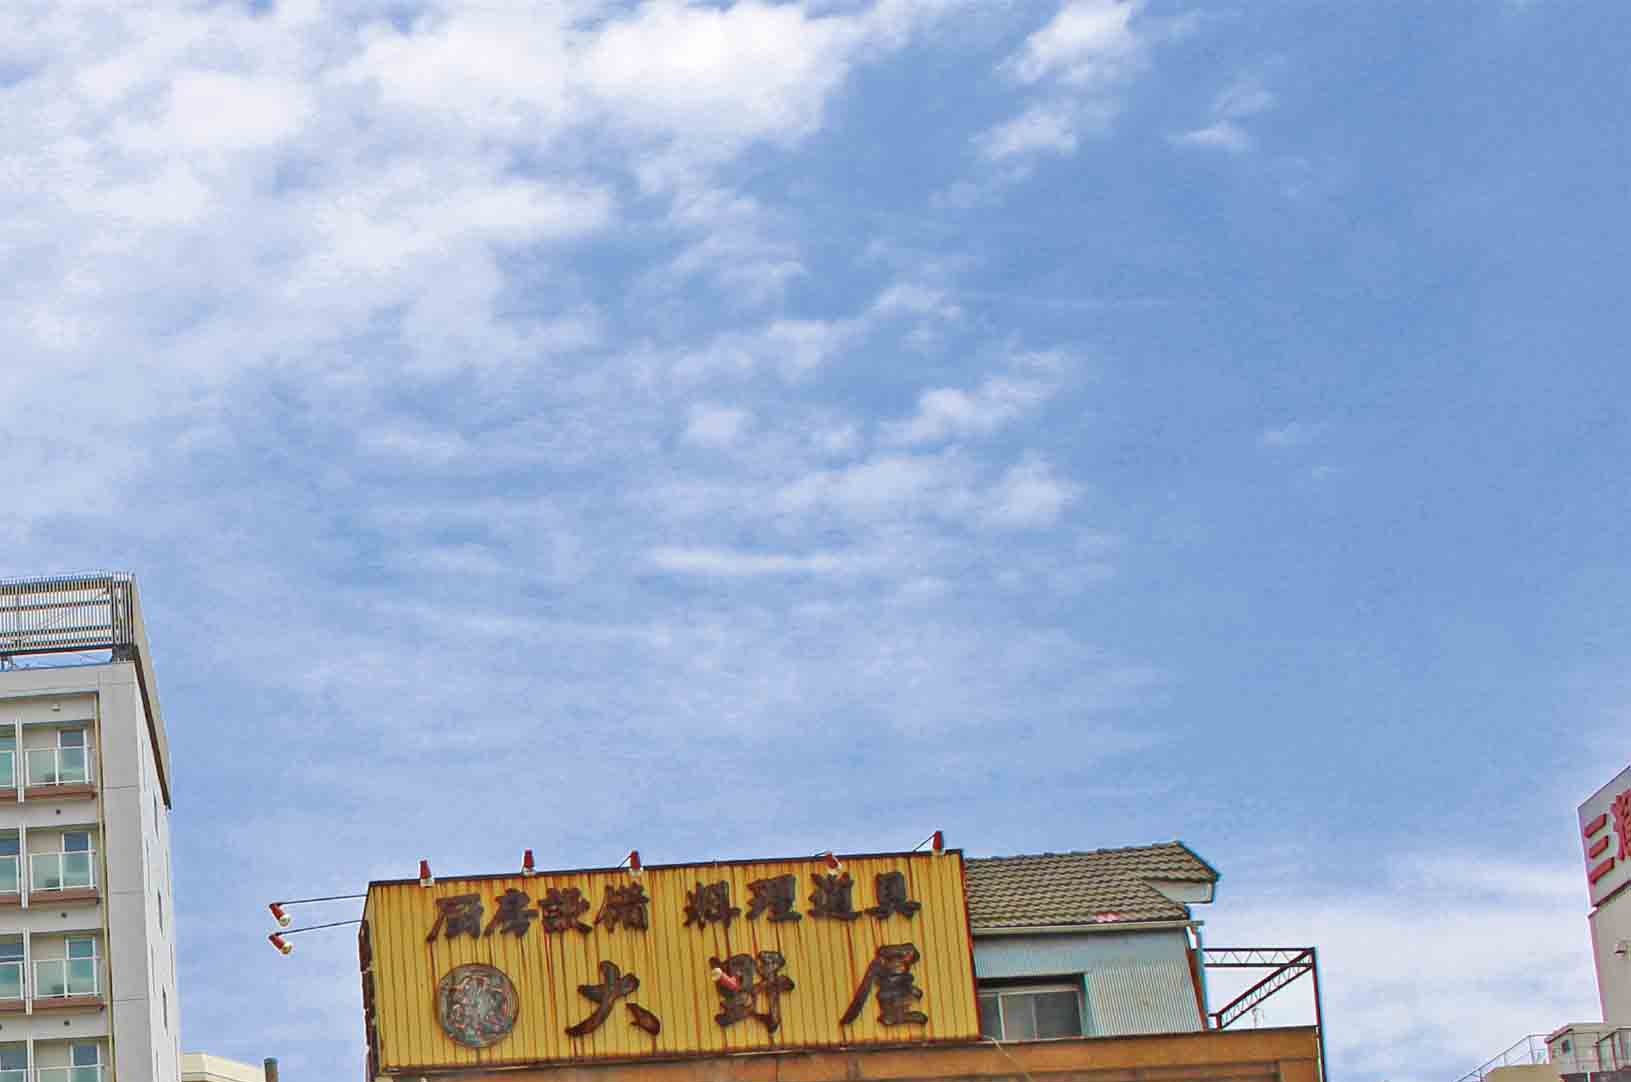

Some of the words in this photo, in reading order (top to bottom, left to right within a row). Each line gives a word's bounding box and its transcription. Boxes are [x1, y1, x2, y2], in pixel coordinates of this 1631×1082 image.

[682, 872, 923, 930] 料理道具
[564, 943, 929, 1037] 大野屋
